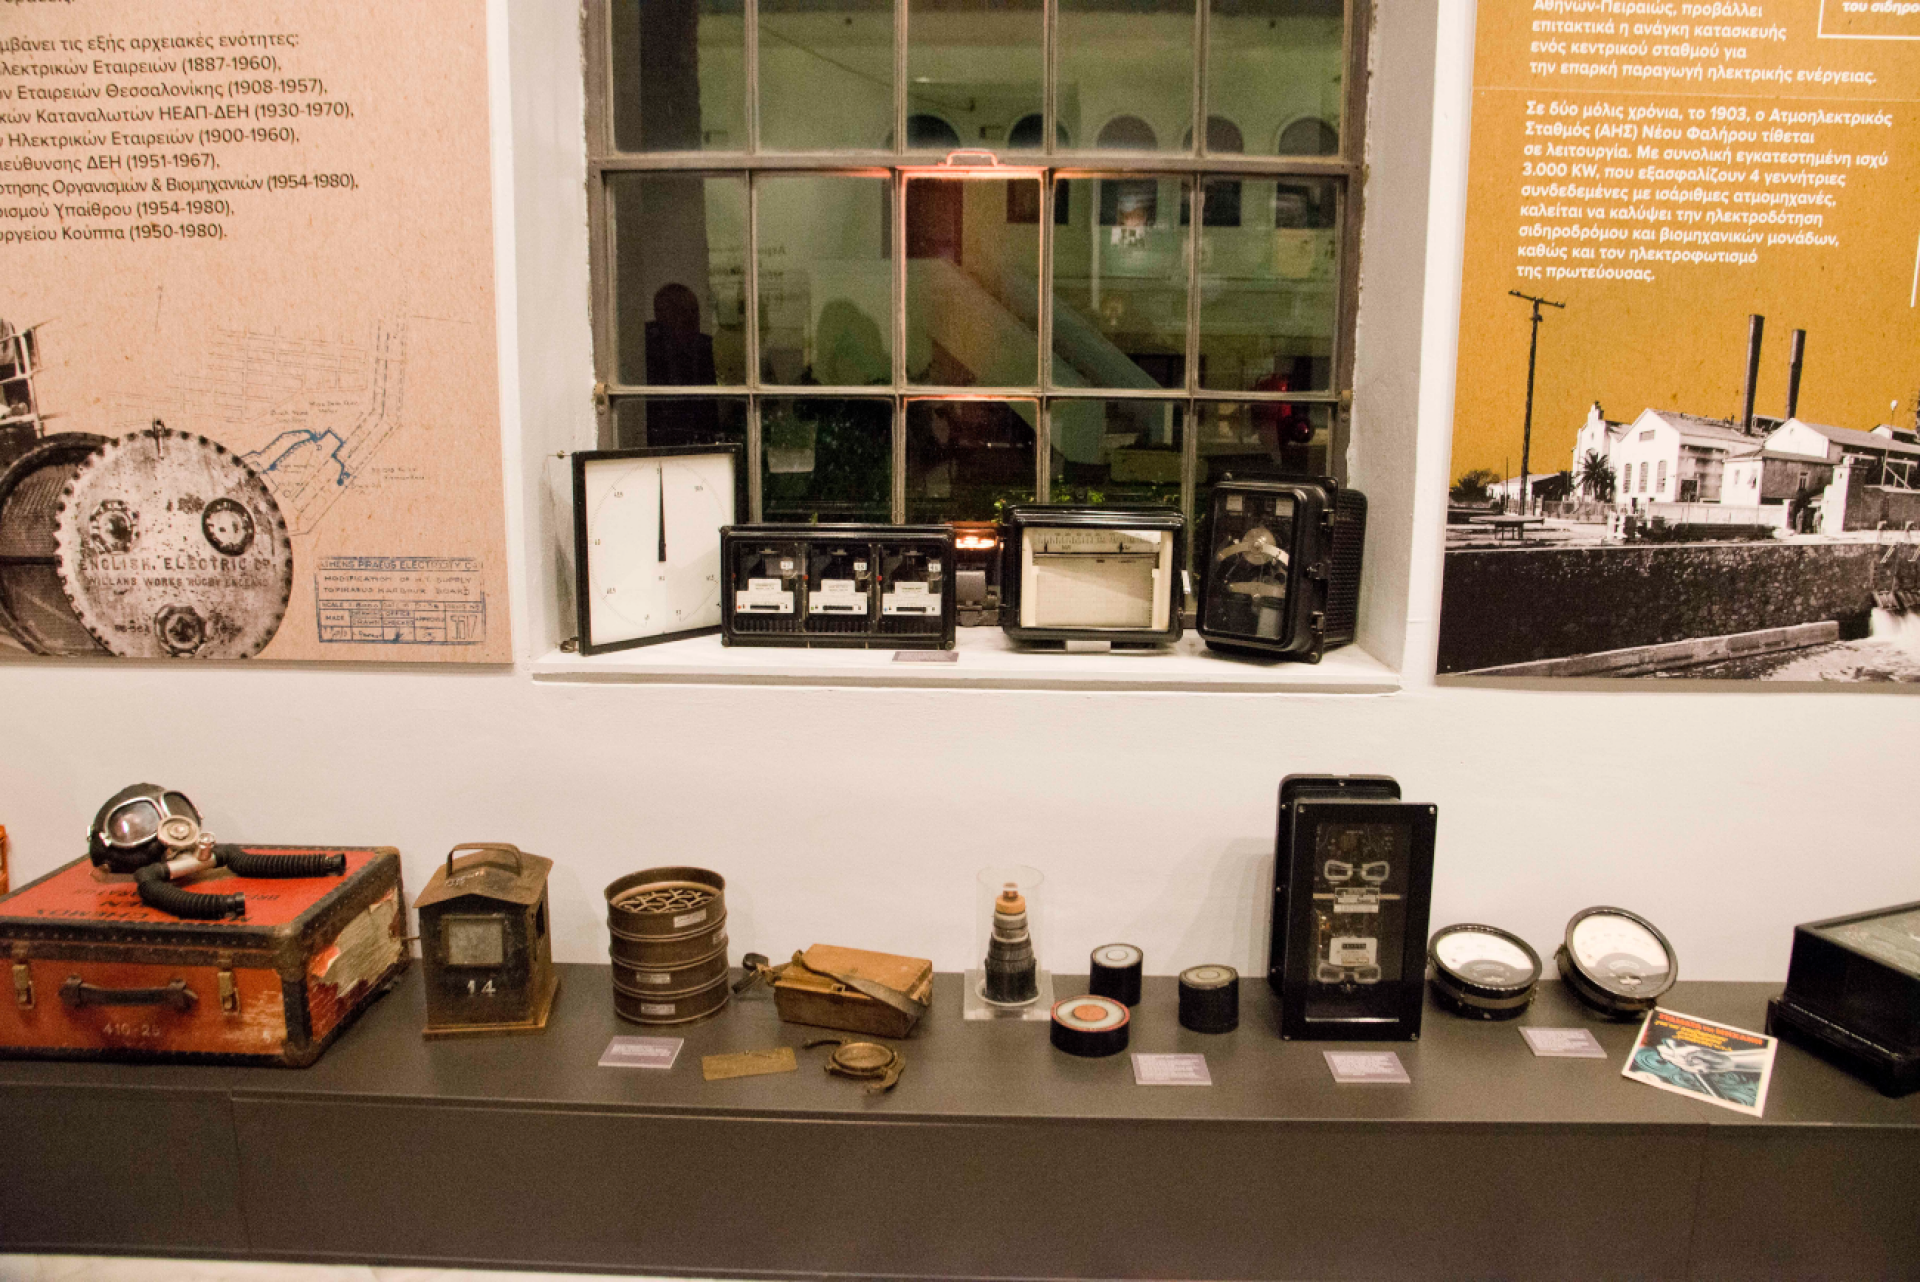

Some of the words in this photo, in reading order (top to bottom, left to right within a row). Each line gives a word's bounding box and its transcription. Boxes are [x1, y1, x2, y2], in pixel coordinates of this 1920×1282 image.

[1681, 1, 1763, 19] προβάλλει
[1841, 1, 1867, 13] του
[1531, 18, 1615, 35] επιτακτικά
[1619, 22, 1630, 38] η
[1633, 19, 1690, 39] ανάγκη
[1693, 23, 1788, 42] κατασκευής
[59, 38, 83, 54] τις
[87, 34, 126, 53] εξής
[130, 32, 214, 52] αρχειακές
[219, 31, 299, 49] ενότητες:
[1529, 36, 1567, 55] ενός
[1570, 39, 1648, 57] κεντρικού
[1652, 42, 1720, 60] σταθμού
[1724, 46, 1748, 62] για
[93, 58, 176, 77] Εταιρειών
[1529, 61, 1557, 77] την
[1559, 59, 1618, 79] επαρκή
[1621, 63, 1704, 82] παραγωγή
[1707, 64, 1794, 84] ηλεκτρικής
[1796, 66, 1878, 86] ενέργειας.
[17, 85, 101, 102] Εταιρειών
[106, 80, 223, 99] Θεσσαλονίκης
[37, 108, 154, 123] Καταναλωτών
[159, 105, 249, 120] ΗΕΑΠ-ΔΕΗ
[1525, 99, 1546, 116] Σε
[1548, 99, 1579, 116] δύο
[1582, 101, 1624, 120] μόλις
[1627, 102, 1684, 122] χρόνια,
[1687, 108, 1707, 121] το
[1709, 105, 1751, 124] 1903,
[1754, 110, 1766, 122] ο
[1768, 107, 1894, 128] Ατμοηλεκτρικός
[8, 130, 106, 149] Ηλεκτρικών
[112, 129, 194, 148] Εταιρειών
[1524, 120, 1591, 140] Σταθμός
[1594, 123, 1639, 141] (ΑΗΣ)
[1642, 123, 1683, 140] Νέου
[1686, 125, 1757, 145] Φαλήρου
[1761, 124, 1816, 144] τίθεται
[87, 155, 121, 170] ΔΕΗ
[1523, 143, 1543, 157] σε
[1545, 141, 1632, 162] λειτουργία.
[1636, 144, 1660, 160] Με
[1663, 146, 1732, 165] συνολική
[1736, 148, 1853, 168] εγκατεστημένη
[1855, 150, 1890, 170] ισχύ
[1521, 160, 1568, 177] 3.000
[1572, 163, 1600, 181] KW,
[1604, 166, 1635, 180] που
[1637, 164, 1747, 184] εξασφαλίζουν
[1749, 168, 1760, 183] 4
[1764, 169, 1847, 188] γεννήτριες
[53, 177, 148, 197] Οργανισμών
[152, 177, 162, 192] &
[166, 175, 263, 194] Βιομηχανιών
[1520, 182, 1630, 204] συνδεδεμένες
[1632, 188, 1652, 203] με
[1655, 186, 1730, 205] ισάριθμες
[1733, 189, 1837, 208] ατμομηχανές,
[53, 201, 132, 221] Υπαίθρου
[1519, 201, 1583, 218] καλείται
[1586, 207, 1606, 219] να
[1609, 204, 1672, 224] καλύψει
[1676, 209, 1703, 224] την
[1705, 207, 1824, 228] ηλεκτροδότηση
[62, 225, 125, 240] Κούππα
[1518, 222, 1629, 244] σιδηροδρόμου
[1632, 228, 1656, 241] και
[1659, 226, 1765, 245] βιομηχανικών
[1767, 230, 1840, 248] μονάδων,
[1517, 241, 1568, 261] καθώς
[1572, 247, 1596, 259] και
[1599, 247, 1626, 260] τον
[1628, 245, 1759, 267] ηλεκτροφωτισμό
[1515, 265, 1543, 280] της
[1545, 263, 1656, 283] πρωτεύουσας.
[164, 557, 246, 571] ELECTRIC
[467, 979, 497, 997] 14
